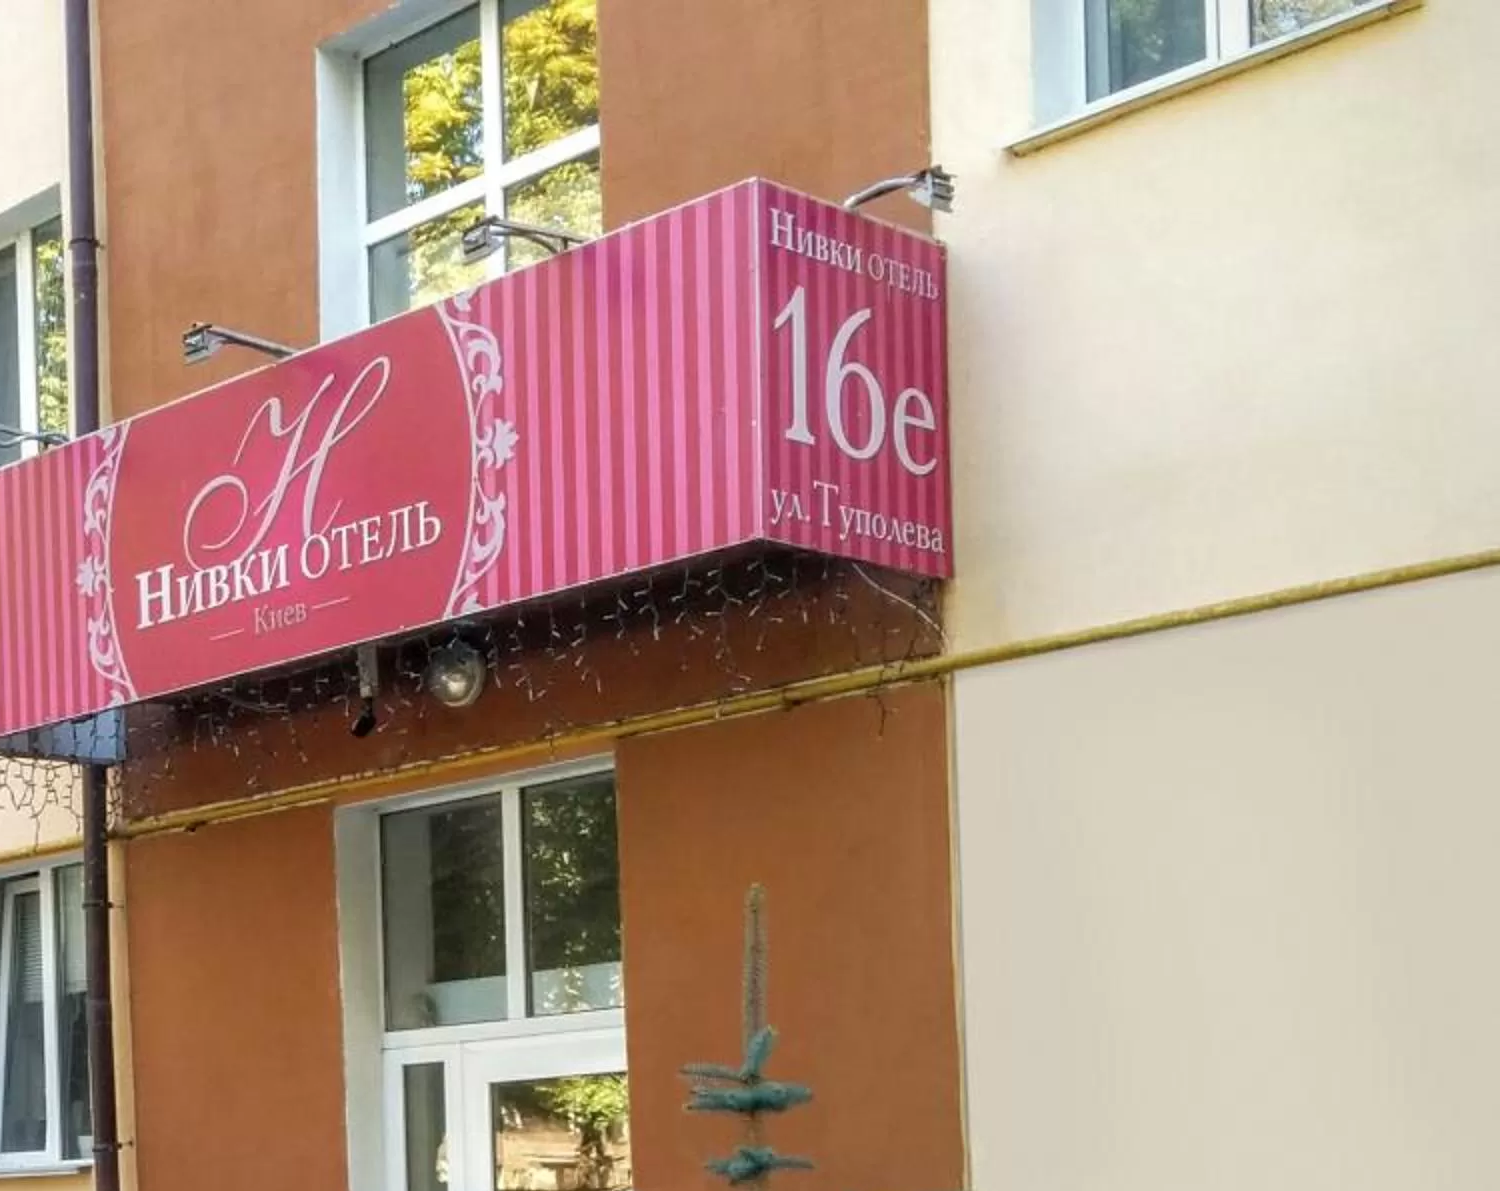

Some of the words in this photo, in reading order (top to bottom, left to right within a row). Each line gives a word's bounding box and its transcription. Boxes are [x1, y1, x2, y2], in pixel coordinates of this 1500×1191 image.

[774, 285, 938, 476] 16е
[770, 488, 811, 525] ул.
[813, 480, 945, 554] Туполева
[253, 602, 307, 635] Киев
